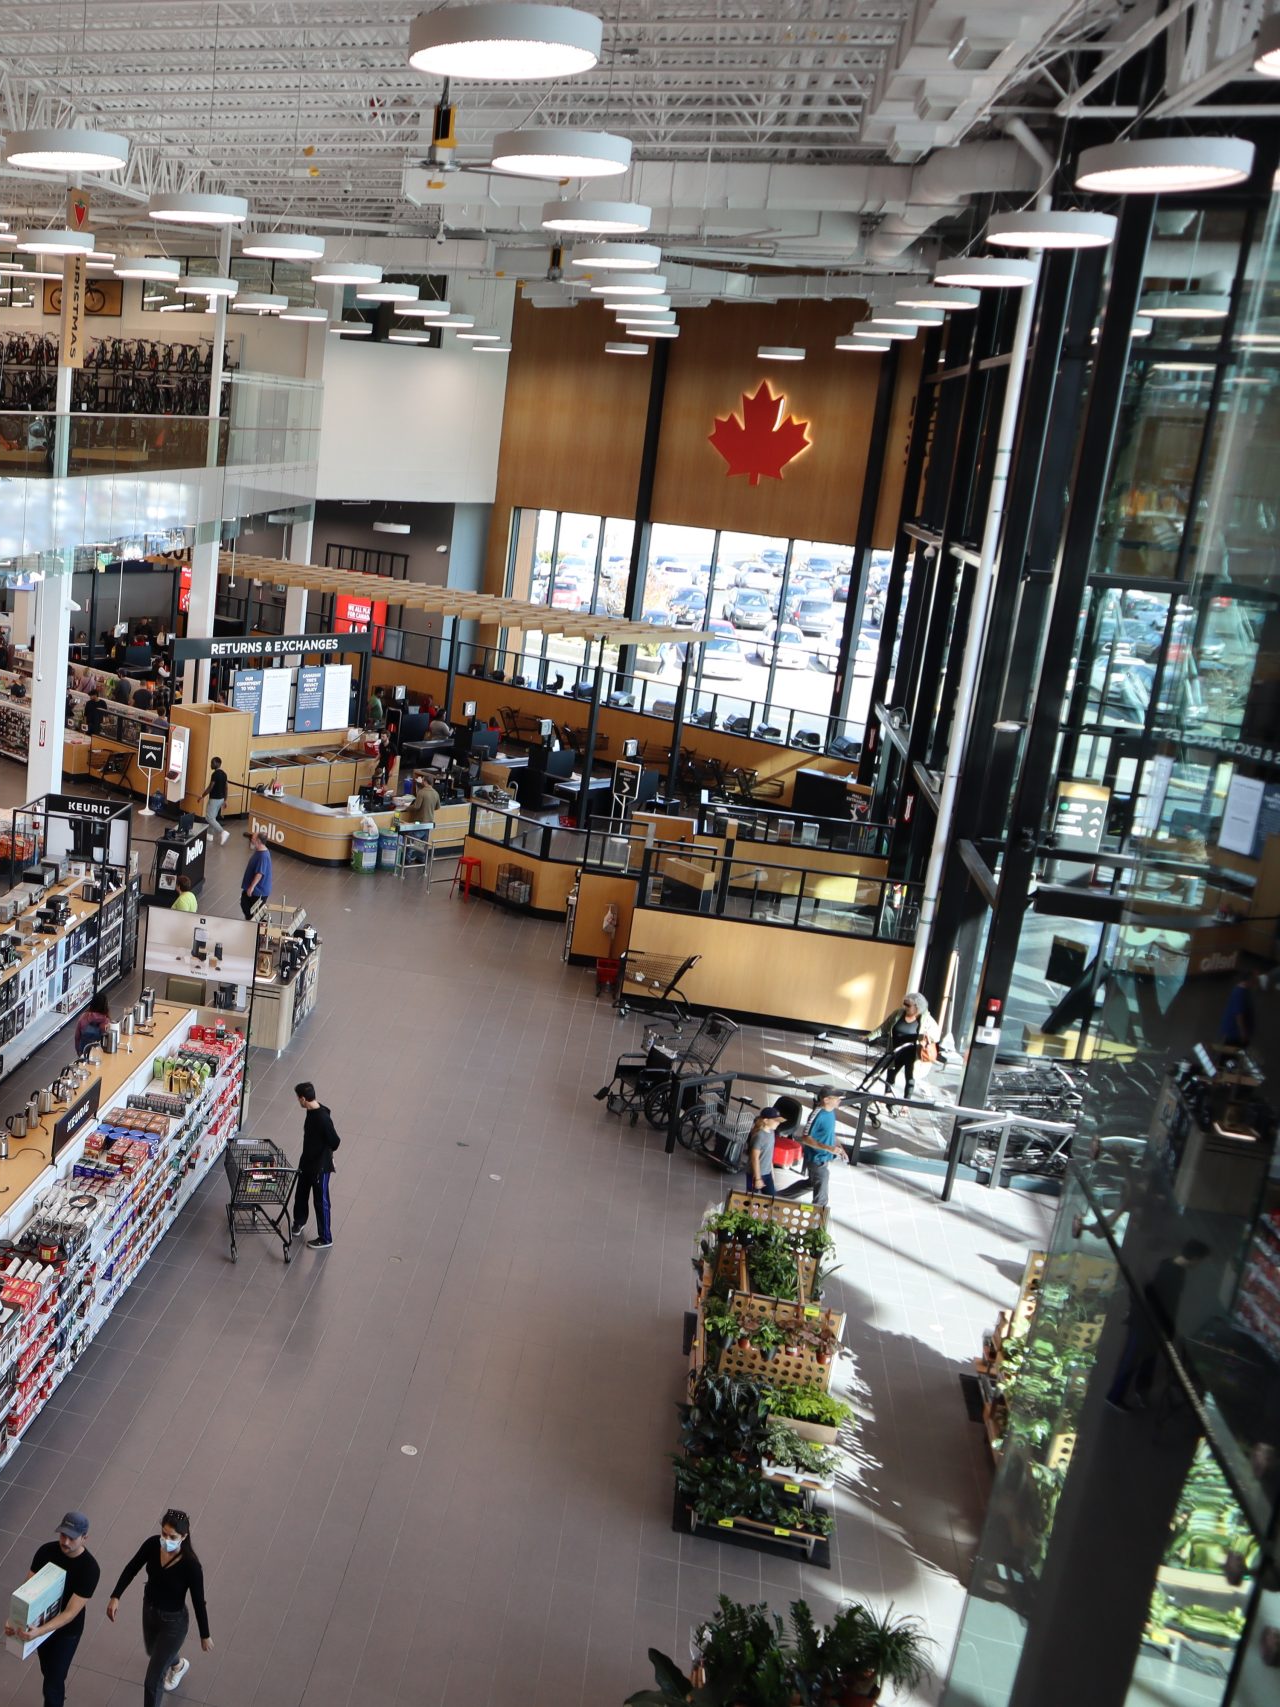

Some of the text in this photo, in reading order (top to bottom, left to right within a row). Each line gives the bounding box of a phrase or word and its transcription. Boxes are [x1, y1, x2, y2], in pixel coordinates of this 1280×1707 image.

[69, 256, 81, 358] HRISTMAS
[121, 623, 126, 633] 2
[211, 638, 338, 655] RETURNS & EXCHANGES
[397, 687, 402, 698] 7
[68, 801, 110, 815] KEURIG
[251, 817, 285, 843] hello
[186, 838, 204, 865] hello
[66, 1100, 90, 1133] KEURIG
